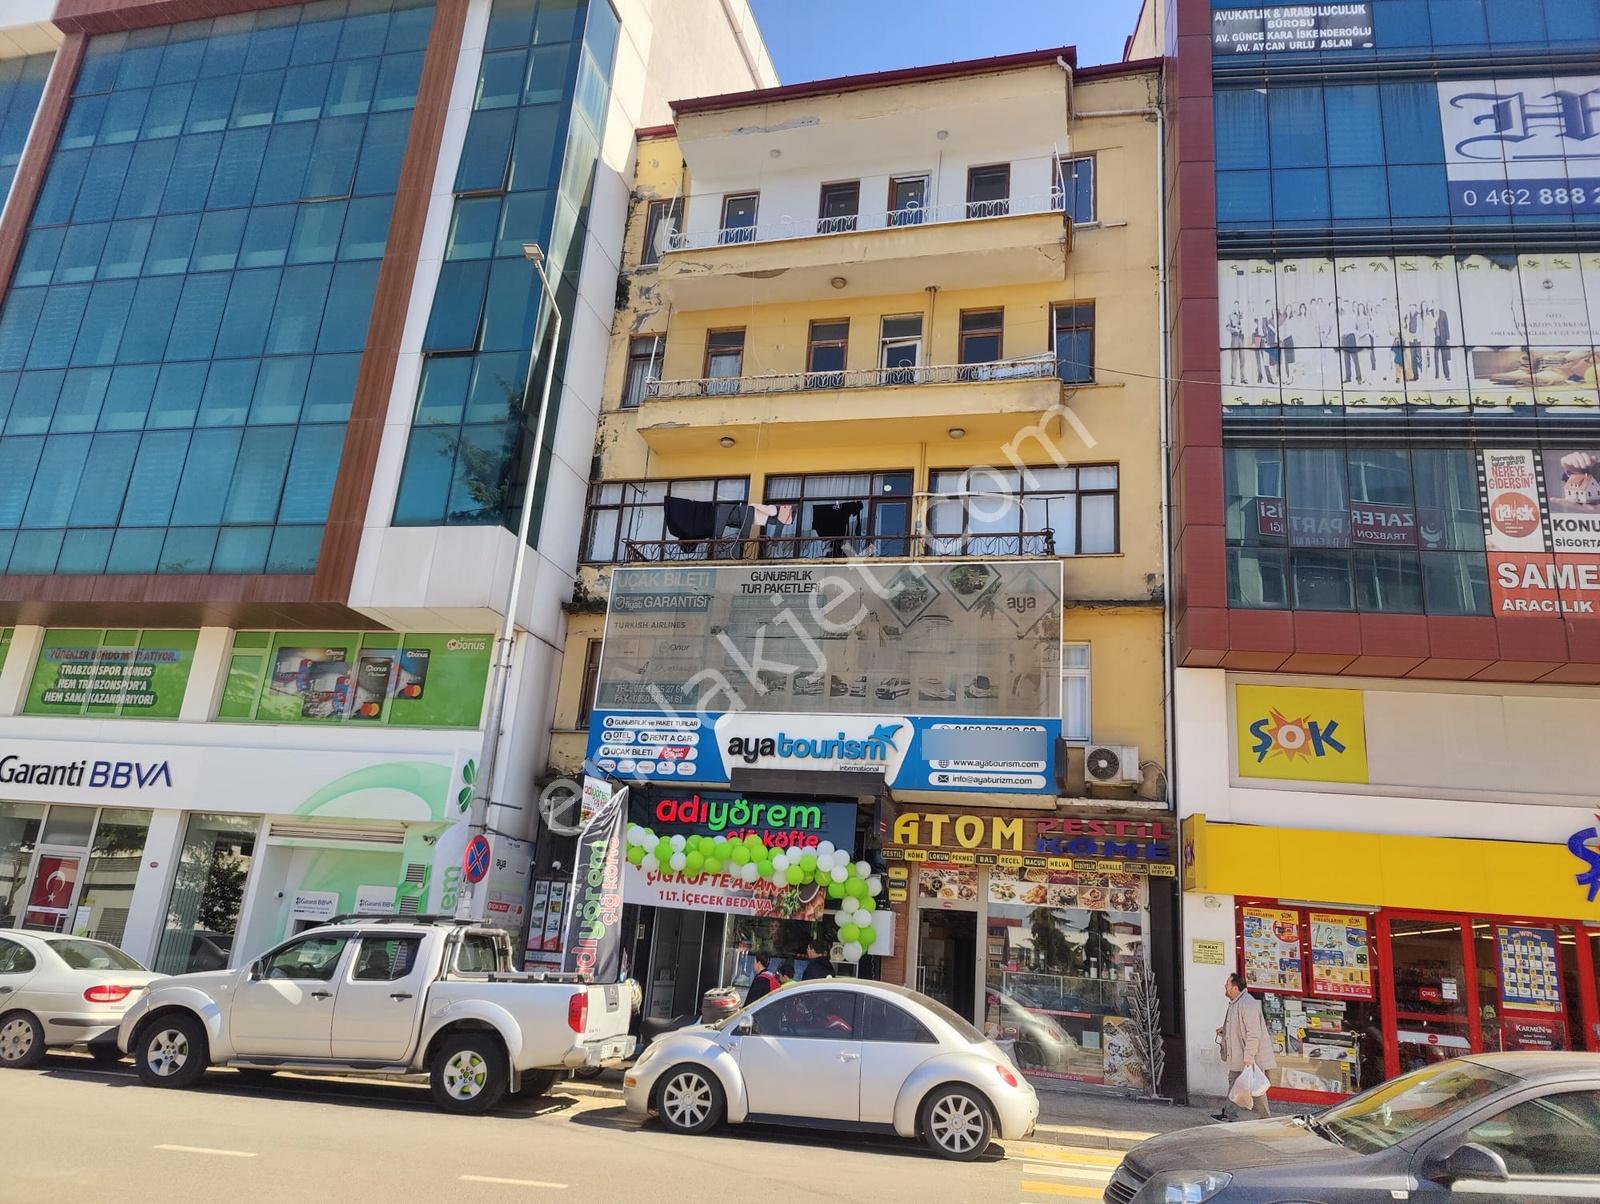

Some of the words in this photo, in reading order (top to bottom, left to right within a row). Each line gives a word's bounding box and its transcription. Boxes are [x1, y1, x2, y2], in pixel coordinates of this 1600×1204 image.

[1215, 9, 1271, 21] AVUKATLIK
[1273, 9, 1280, 18] &
[1284, 4, 1366, 18] ARABULUCULUK
[1267, 18, 1315, 29] BÜROSU
[1215, 34, 1230, 43] AV.
[1232, 31, 1264, 42] GÜNCE
[1267, 31, 1294, 40] KARA
[1296, 26, 1372, 39] İSKENDEROĞLU
[1236, 43, 1250, 52] AV.
[1252, 42, 1285, 51] AYCAN
[1289, 41, 1315, 50] URLU
[1320, 39, 1353, 48] ASLAN
[1463, 190, 1477, 206] 0
[1486, 189, 1531, 205] 462
[1539, 188, 1586, 204] 888
[1491, 466, 1526, 478] NEREYE
[750, 570, 812, 582] GÜNÜBİRLİK
[1497, 562, 1600, 590] SAME
[741, 583, 762, 594] TUR
[763, 582, 821, 593] PAKETLERİ
[644, 595, 709, 609] GARANTİSİ
[1006, 597, 1036, 613] aya
[1502, 599, 1594, 613] ARACILIK
[650, 621, 686, 629] AIRLINES
[61, 665, 125, 676] TRABZONSPOR
[58, 679, 76, 689] HEM
[44, 692, 63, 702] HEM
[64, 692, 86, 703] SANA
[1249, 718, 1346, 763] ŞOK
[0, 755, 86, 787] Garanti
[89, 760, 172, 789] BBVA
[952, 775, 1032, 785] info@ayaturizm.com
[656, 794, 821, 831] adıyörem
[893, 812, 1024, 851] ATOM
[929, 852, 949, 861] LOKUM
[1050, 860, 1070, 868] HELVA
[666, 891, 679, 901] LT.
[682, 890, 723, 906] İÇECEK
[725, 896, 773, 910] BEDAVA
